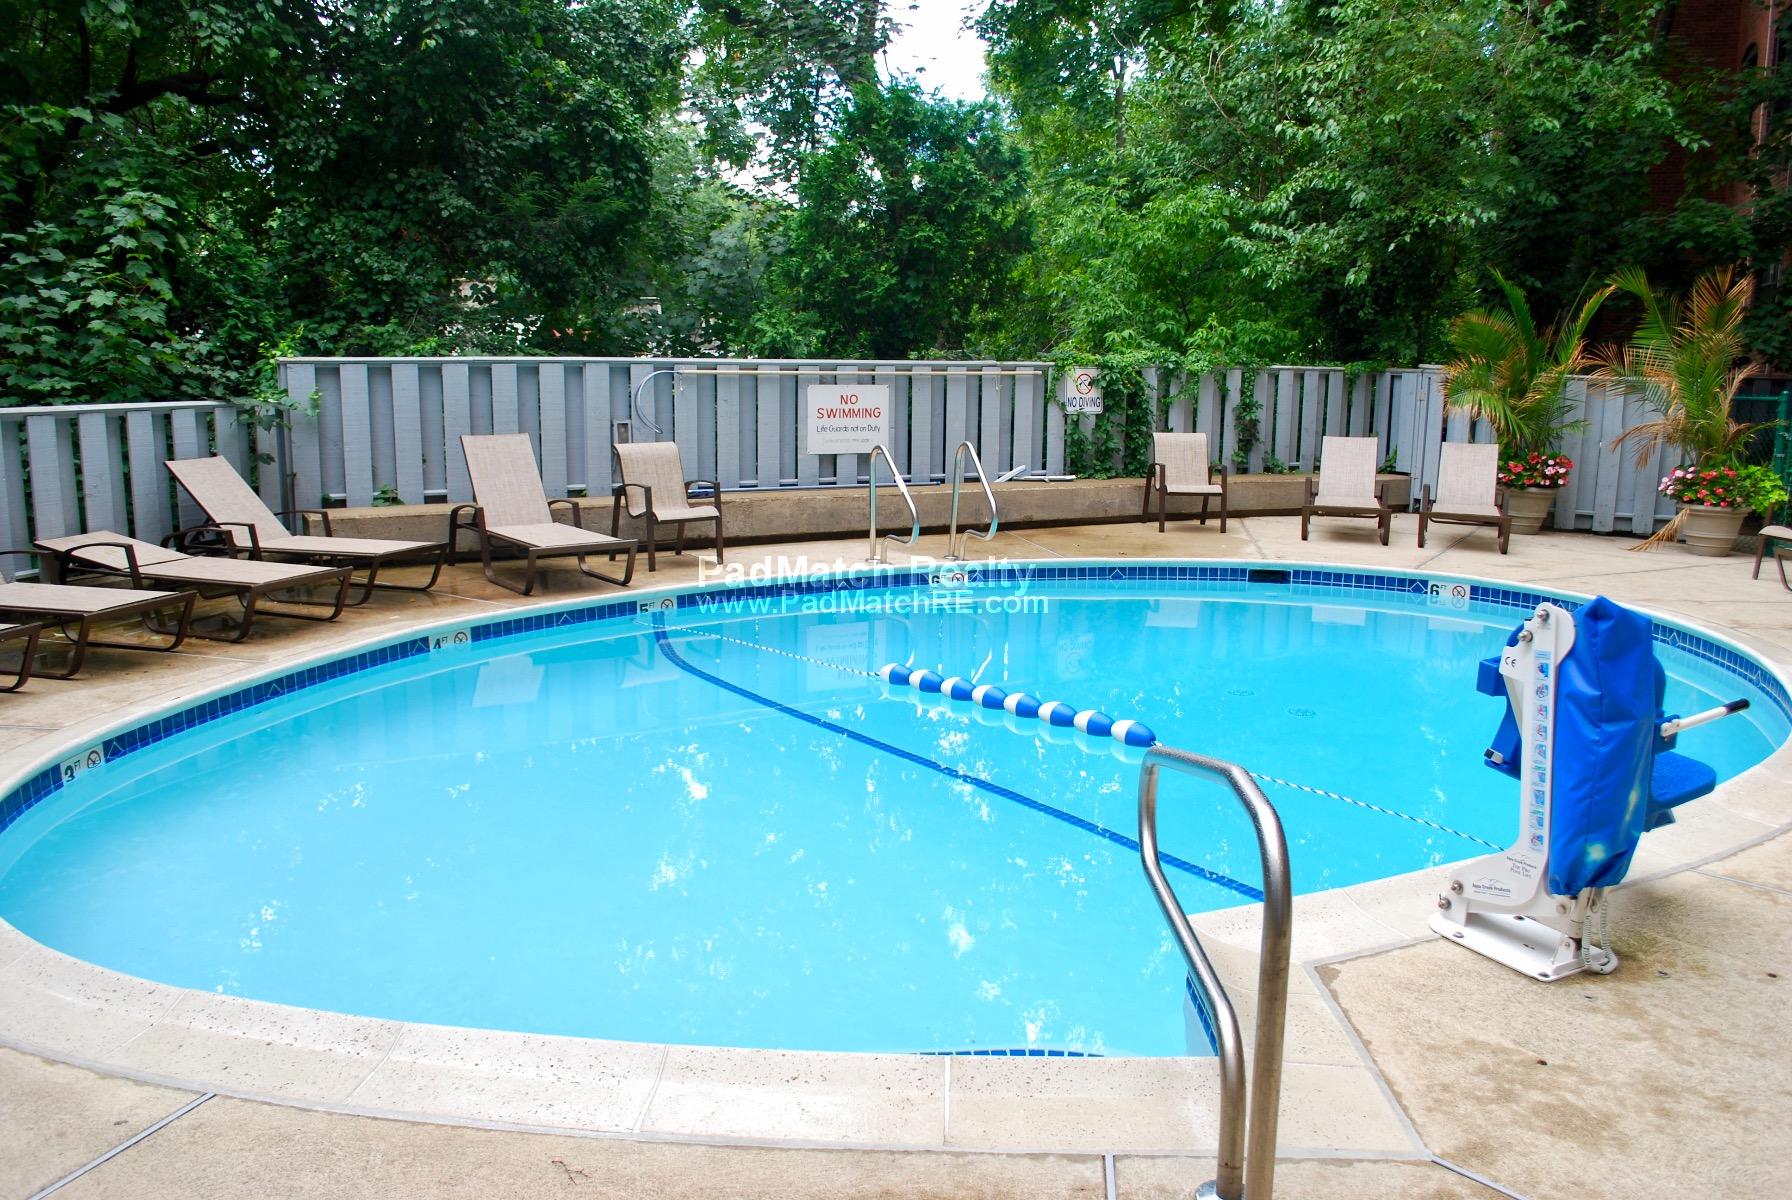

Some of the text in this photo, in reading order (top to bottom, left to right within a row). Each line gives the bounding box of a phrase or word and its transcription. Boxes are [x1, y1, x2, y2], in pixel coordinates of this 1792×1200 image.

[840, 394, 858, 405] NO
[1067, 396, 1101, 408] NO DIVING
[816, 407, 881, 419] SWIMMING
[816, 424, 828, 433] Life
[828, 424, 850, 433] Guards
[850, 424, 859, 432] not
[867, 424, 881, 433] Duty
